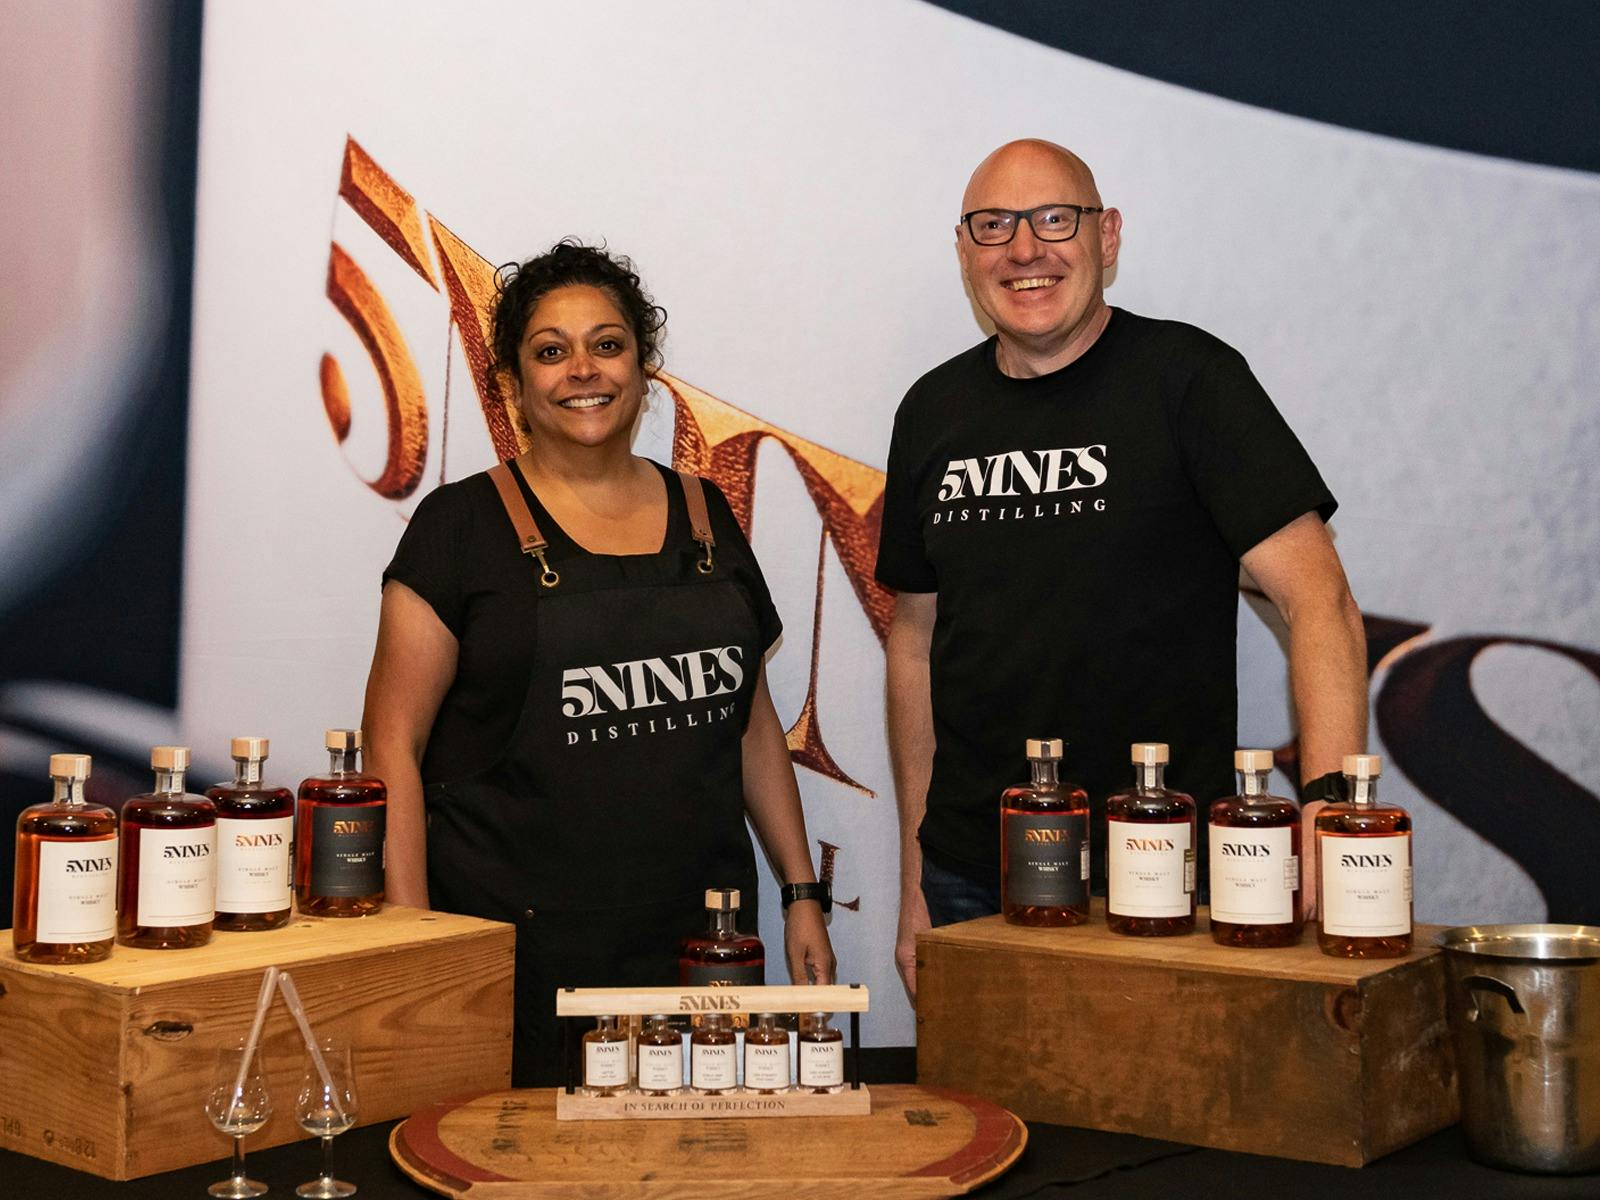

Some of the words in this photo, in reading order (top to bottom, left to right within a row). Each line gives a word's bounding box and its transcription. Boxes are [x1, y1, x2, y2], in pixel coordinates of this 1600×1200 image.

[938, 444, 1108, 502] 5NINES
[933, 499, 1106, 524] DISTILLING
[562, 645, 744, 718] 5NINES
[235, 833, 283, 847] 5NINES
[1024, 828, 1071, 844] 5NINES
[163, 843, 210, 859] 5NINES
[1126, 838, 1174, 851] 5NINES
[1222, 843, 1270, 857] 5NINES
[66, 856, 112, 873] 5NINES
[1341, 854, 1392, 867] 5NINES
[680, 995, 741, 1011] 5NINES
[624, 1103, 637, 1111] IN
[641, 1102, 687, 1111] SEARCH
[691, 1102, 704, 1111] OF
[711, 1100, 785, 1110] PERFECTION
